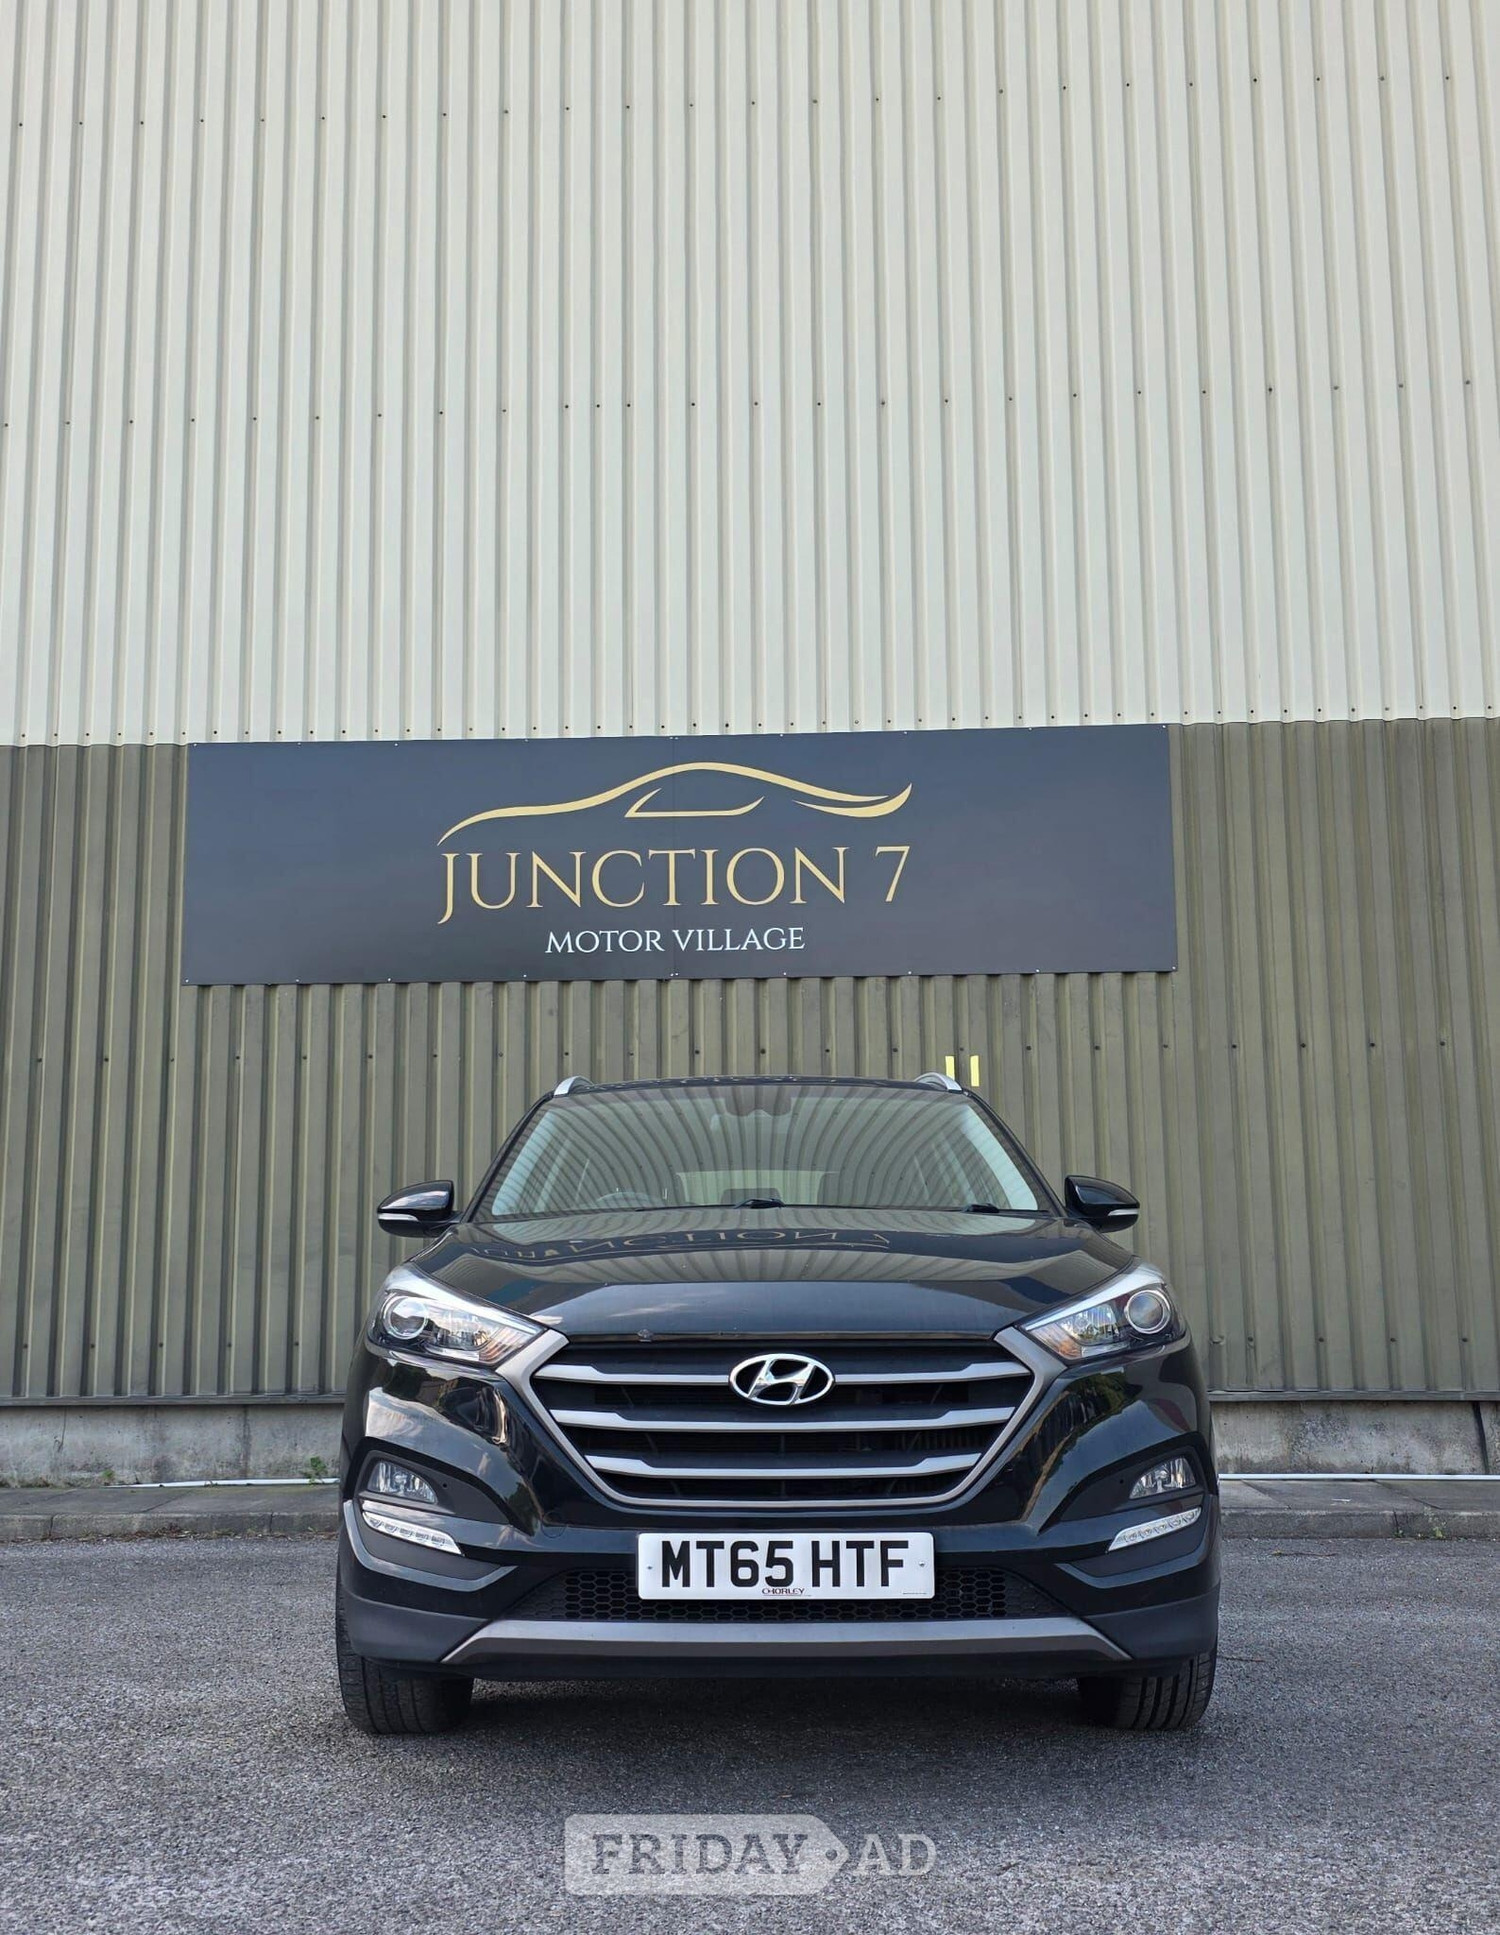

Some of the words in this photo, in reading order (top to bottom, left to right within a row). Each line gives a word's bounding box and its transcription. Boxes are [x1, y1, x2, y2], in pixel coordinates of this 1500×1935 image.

[438, 846, 849, 924] JUNCTION
[875, 846, 911, 903] 7
[545, 930, 665, 954] MOTOR
[673, 927, 806, 952] VILLAGE
[661, 1540, 794, 1588] MT65
[811, 1540, 909, 1588] HTF
[761, 1587, 805, 1595] CHORLEY
